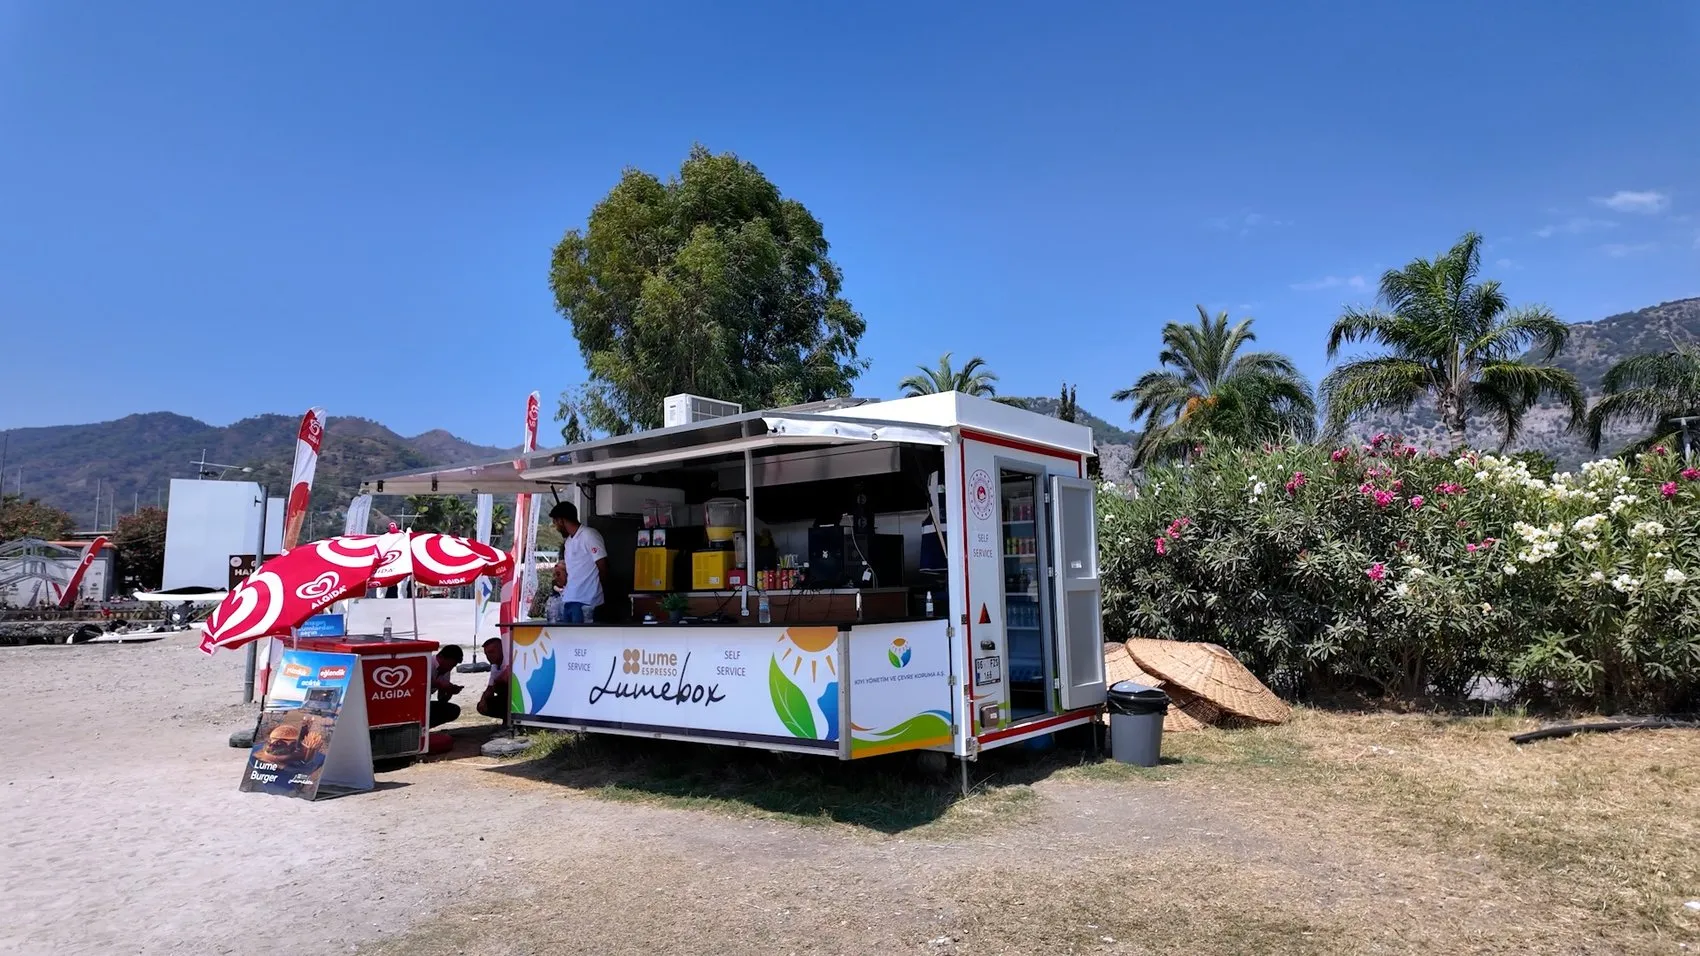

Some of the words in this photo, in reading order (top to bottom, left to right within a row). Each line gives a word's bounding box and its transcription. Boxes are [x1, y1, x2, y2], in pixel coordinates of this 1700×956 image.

[977, 533, 989, 542] SELF
[973, 548, 993, 558] SERVICE
[311, 585, 348, 610] ALGIDA
[574, 648, 588, 657] SELF
[641, 649, 678, 666] Lume
[724, 650, 741, 660] SELF
[567, 662, 591, 672] SERVICE
[641, 667, 678, 677] ESPRESSO
[716, 666, 746, 677] SERVICE
[589, 651, 726, 707] Lumebox
[371, 689, 412, 700] ALGIDA
[253, 760, 278, 771] Lume
[250, 770, 279, 784] Burger
